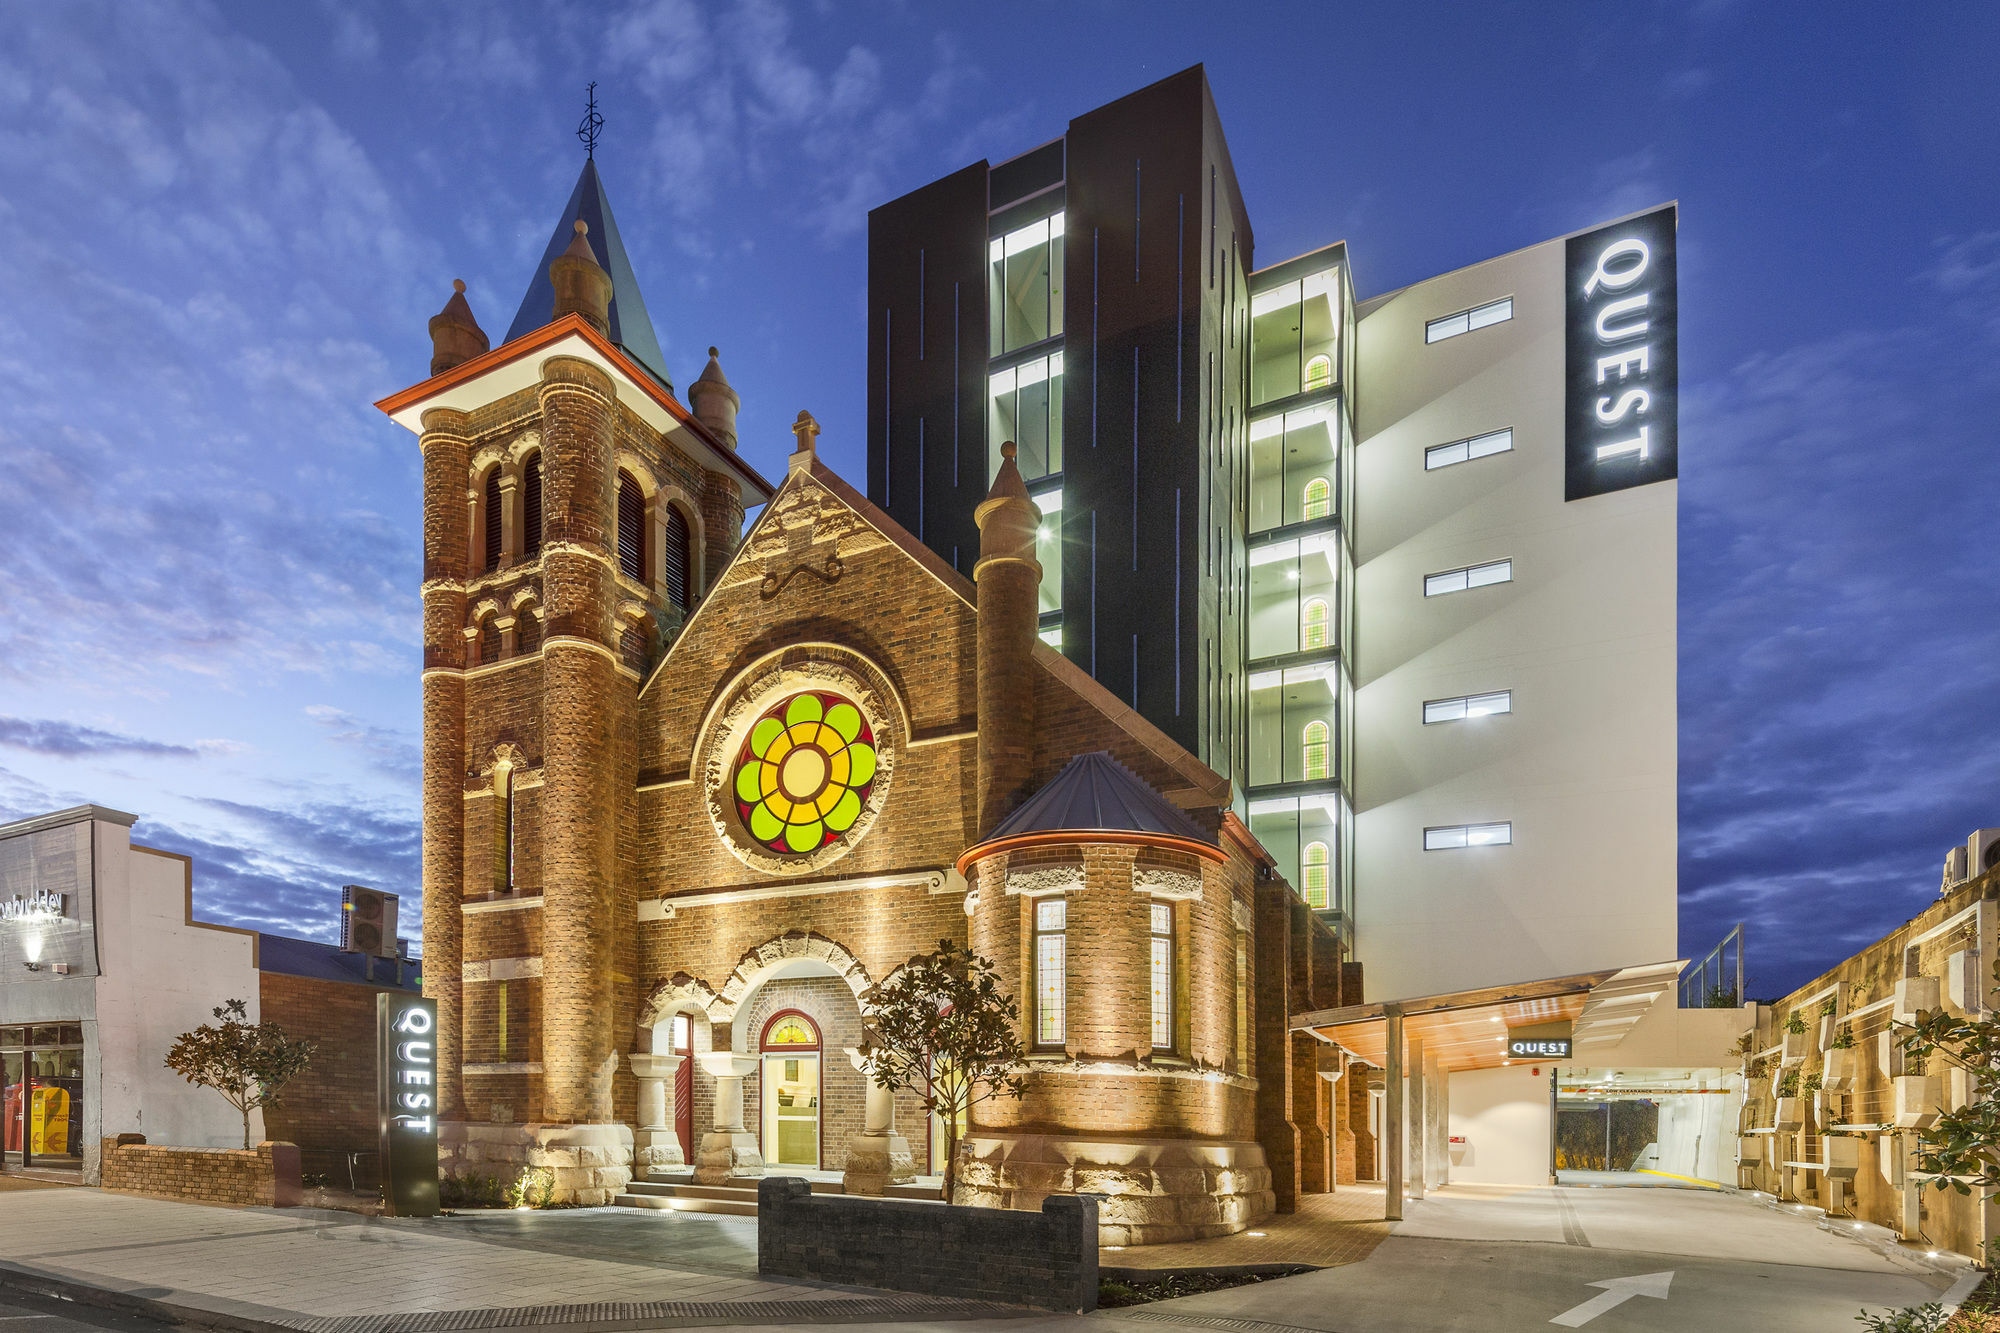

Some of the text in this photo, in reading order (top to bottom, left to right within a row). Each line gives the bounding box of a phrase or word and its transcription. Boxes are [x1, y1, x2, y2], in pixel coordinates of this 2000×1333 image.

[1583, 238, 1650, 462] QUEST
[397, 1007, 432, 1133] QUEST
[1512, 1042, 1568, 1055] QUEST
